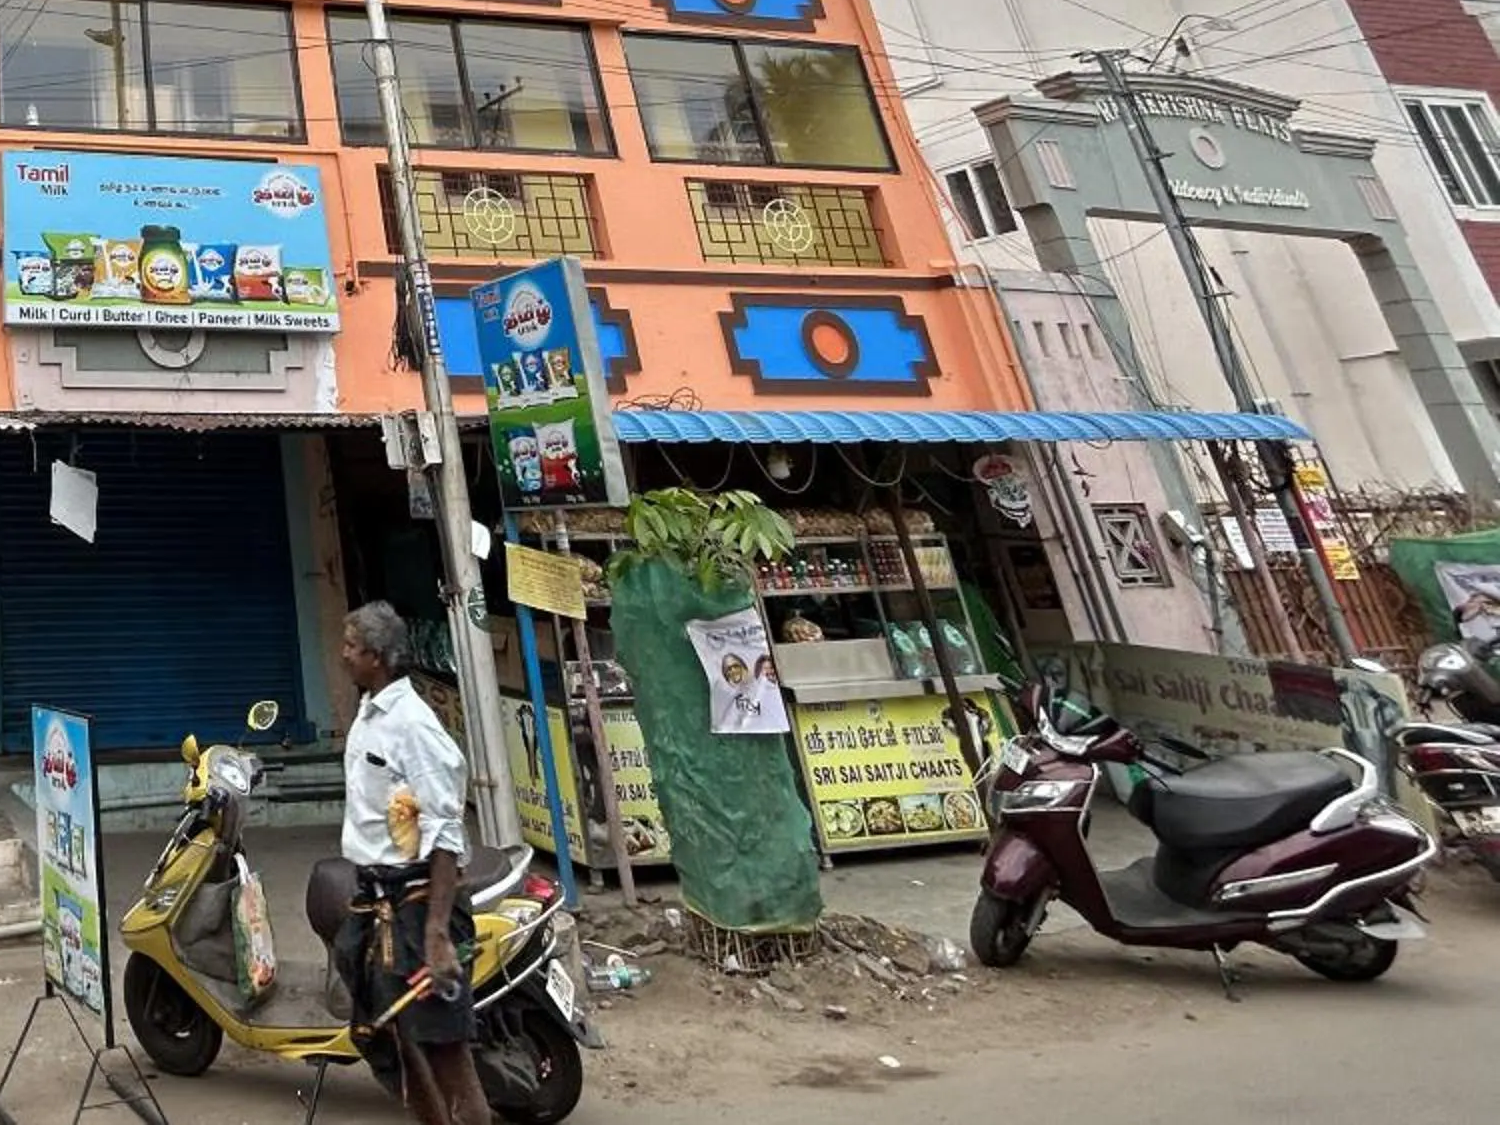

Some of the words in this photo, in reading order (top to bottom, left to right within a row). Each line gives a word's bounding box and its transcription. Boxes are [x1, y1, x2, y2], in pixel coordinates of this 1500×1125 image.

[1095, 91, 1227, 125] RAAKRISHNA
[16, 163, 70, 184] Tamil
[40, 183, 70, 197] Milk
[18, 306, 48, 320] Milk
[58, 308, 92, 322] Curd
[103, 309, 143, 323] Butter
[155, 310, 189, 324] Ghee
[199, 311, 243, 326] Paneer
[253, 313, 282, 326] Milk
[283, 314, 330, 328] Sweets
[813, 765, 837, 786] SRI
[840, 764, 863, 784] SAI
[910, 758, 963, 780] CHAATS
